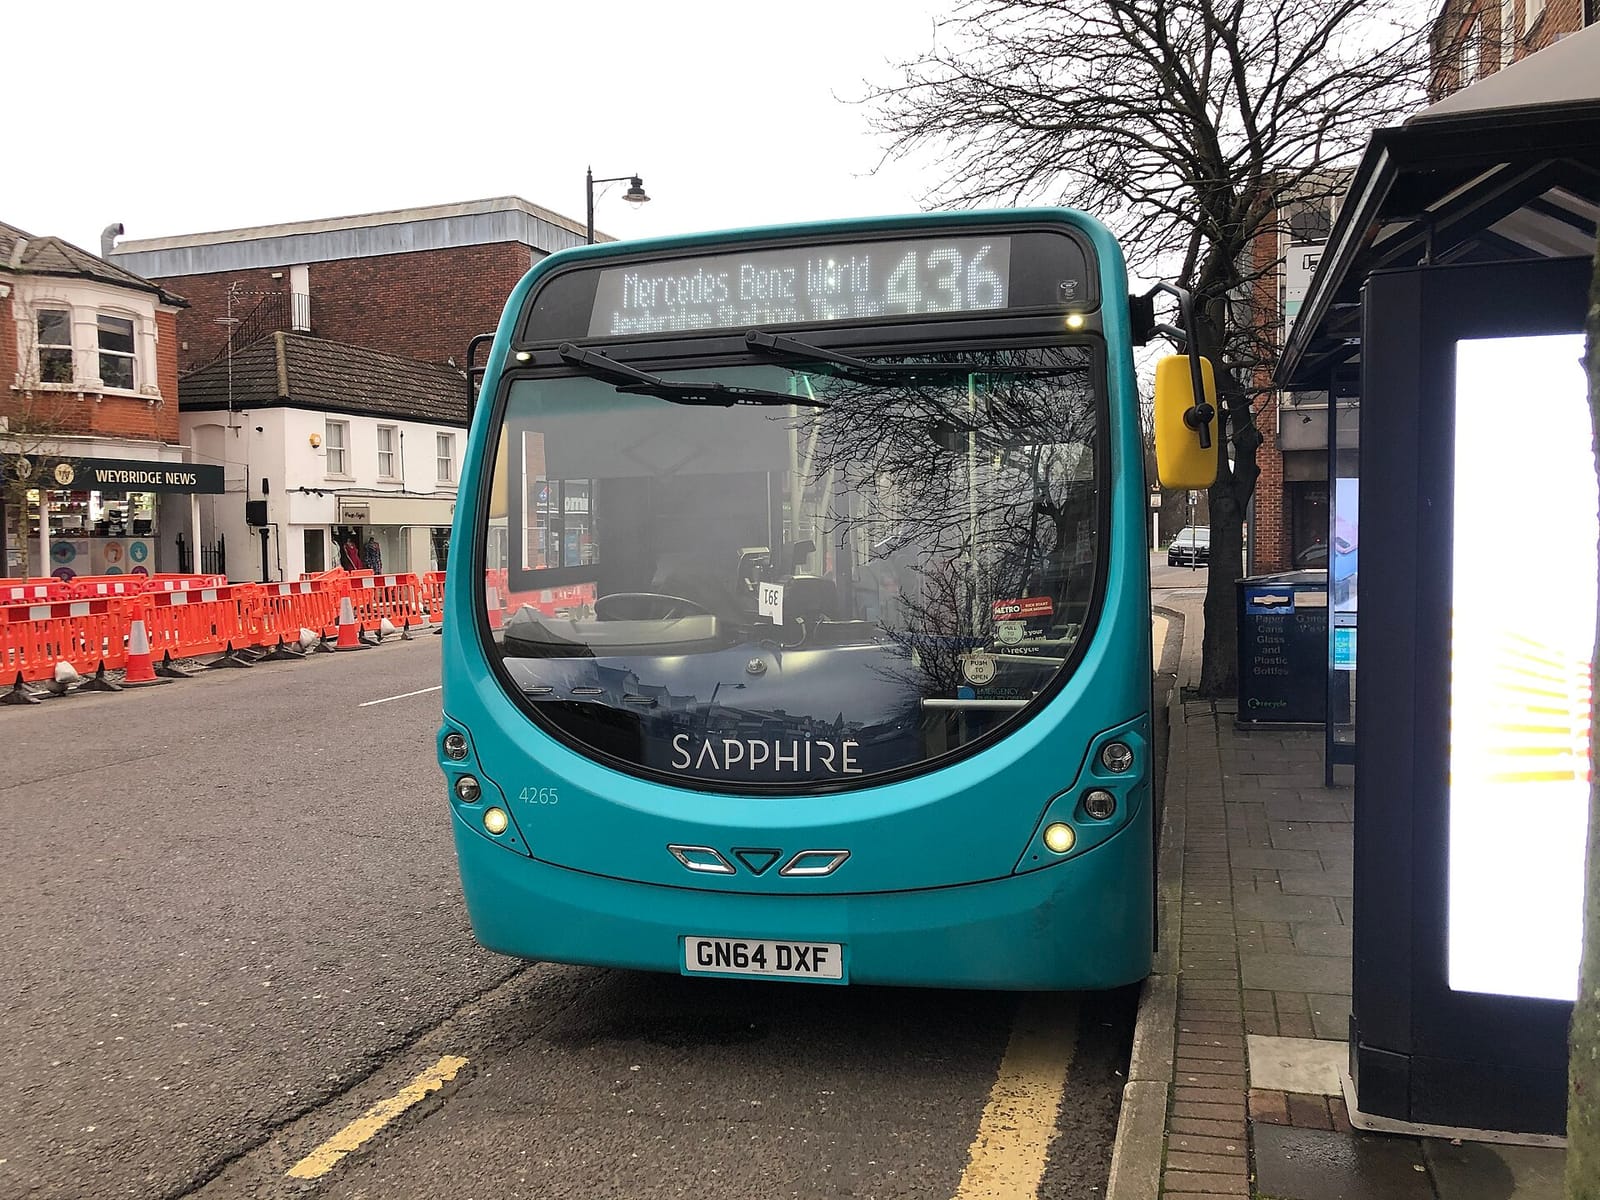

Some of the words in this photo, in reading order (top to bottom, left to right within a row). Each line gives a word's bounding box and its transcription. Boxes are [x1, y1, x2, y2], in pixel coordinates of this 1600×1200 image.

[623, 267, 729, 309] Mercedes
[740, 263, 796, 301] Benz
[807, 255, 870, 296] World
[887, 245, 1003, 313] 436
[95, 469, 162, 485] WEYBRIDGE
[165, 471, 197, 486] NEWS
[764, 588, 779, 606] 391
[994, 605, 1020, 615] METRO
[1255, 614, 1285, 624] Paper
[1257, 625, 1284, 634] Cans
[1256, 635, 1285, 644] Glass
[1261, 645, 1281, 655] and
[1254, 655, 1289, 665] Plastic
[1253, 666, 1289, 676] Bottles
[671, 733, 863, 774] SAPPHIRE
[518, 786, 559, 805] 4265
[696, 941, 768, 970] GN64
[775, 944, 829, 973] DXF
